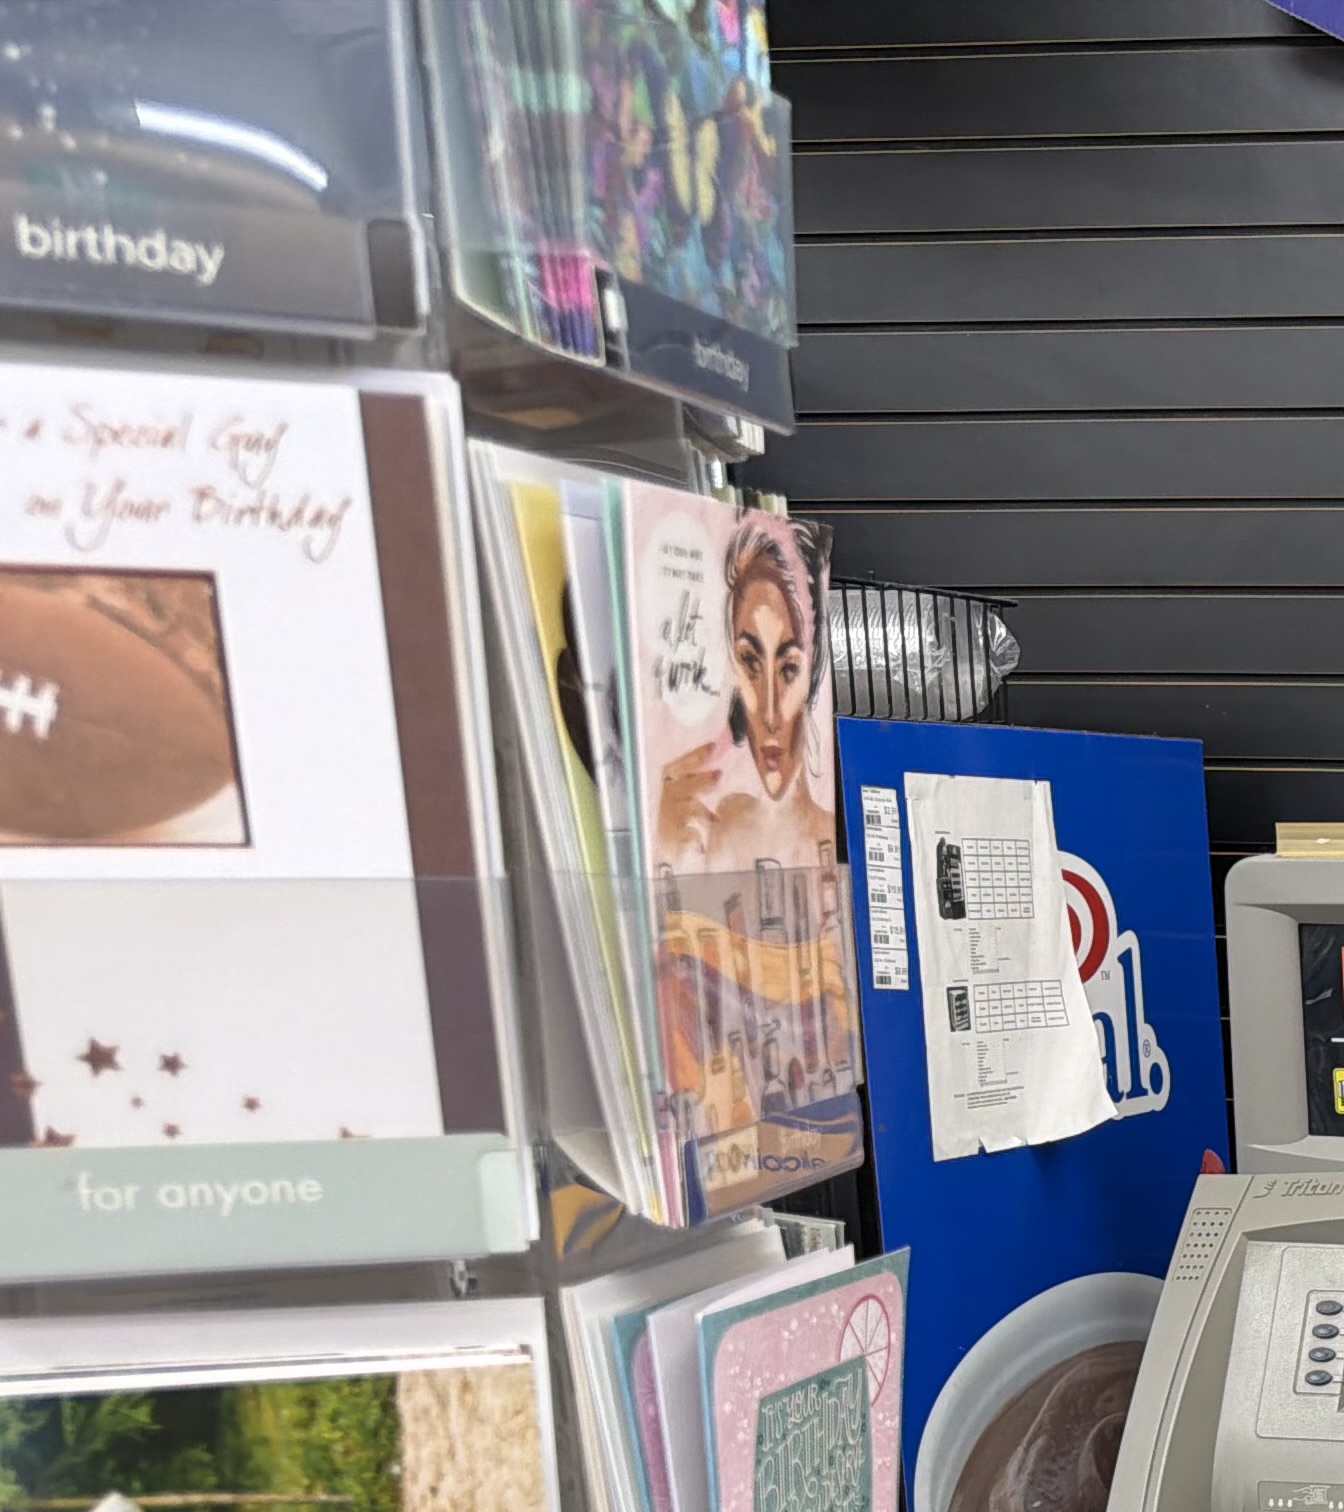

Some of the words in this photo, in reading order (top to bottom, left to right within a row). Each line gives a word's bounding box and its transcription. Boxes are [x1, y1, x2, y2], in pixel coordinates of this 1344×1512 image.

[14, 212, 225, 287] birthday
[692, 338, 750, 392] birthday
[190, 486, 353, 564] Birthday
[75, 1172, 139, 1213] for
[157, 1172, 326, 1227] anyone
